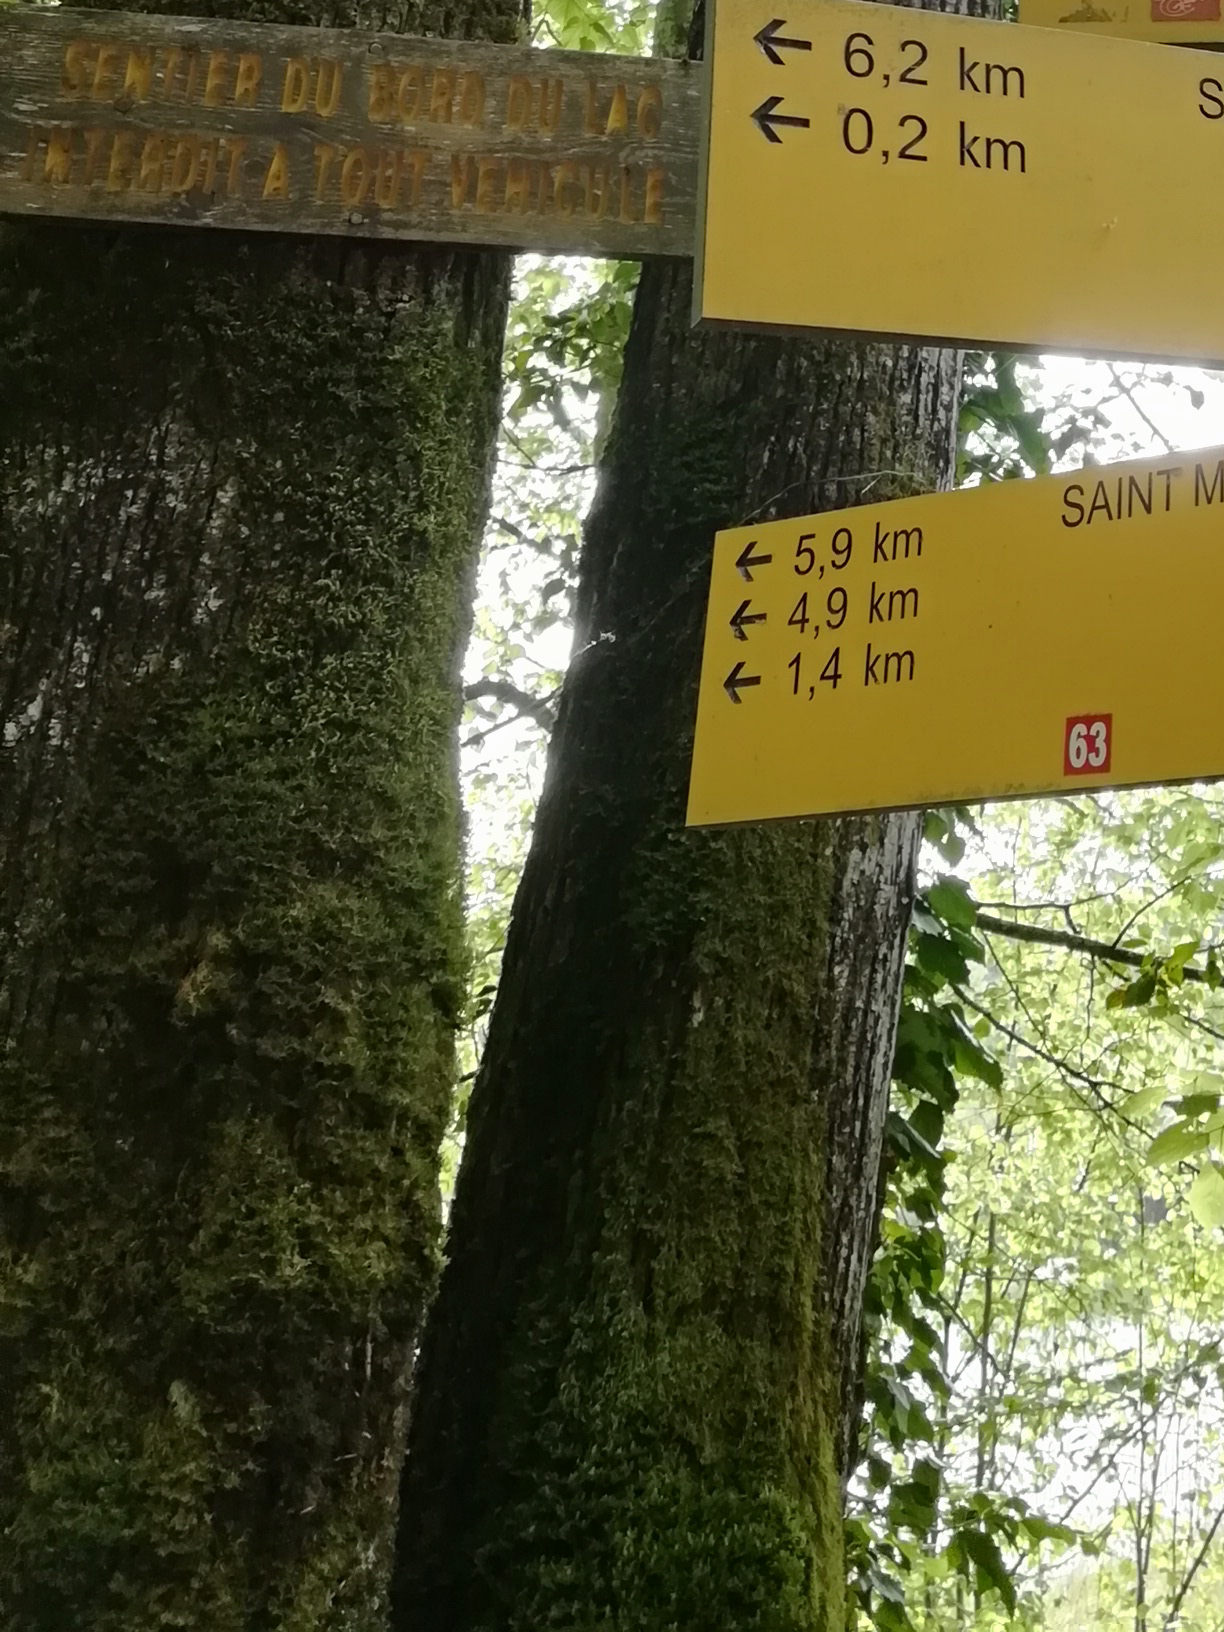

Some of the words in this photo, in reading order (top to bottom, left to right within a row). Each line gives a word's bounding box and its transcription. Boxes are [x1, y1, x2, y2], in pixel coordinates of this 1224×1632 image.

[62, 39, 263, 108] SENTIER
[281, 56, 344, 117] DU
[507, 74, 564, 134] DU
[584, 79, 663, 140] LAC
[843, 32, 928, 88] 6,2
[959, 46, 1025, 99] km
[842, 107, 928, 165] 0,2
[959, 120, 1026, 173] km
[262, 143, 290, 200] A
[1061, 467, 1183, 530] SAINT
[793, 526, 853, 580] 5,9
[873, 521, 924, 564] km
[787, 586, 848, 640] 4,9
[868, 581, 920, 624] km
[787, 646, 843, 701] 1,4
[864, 642, 916, 687] km
[1068, 720, 1109, 770] 63
